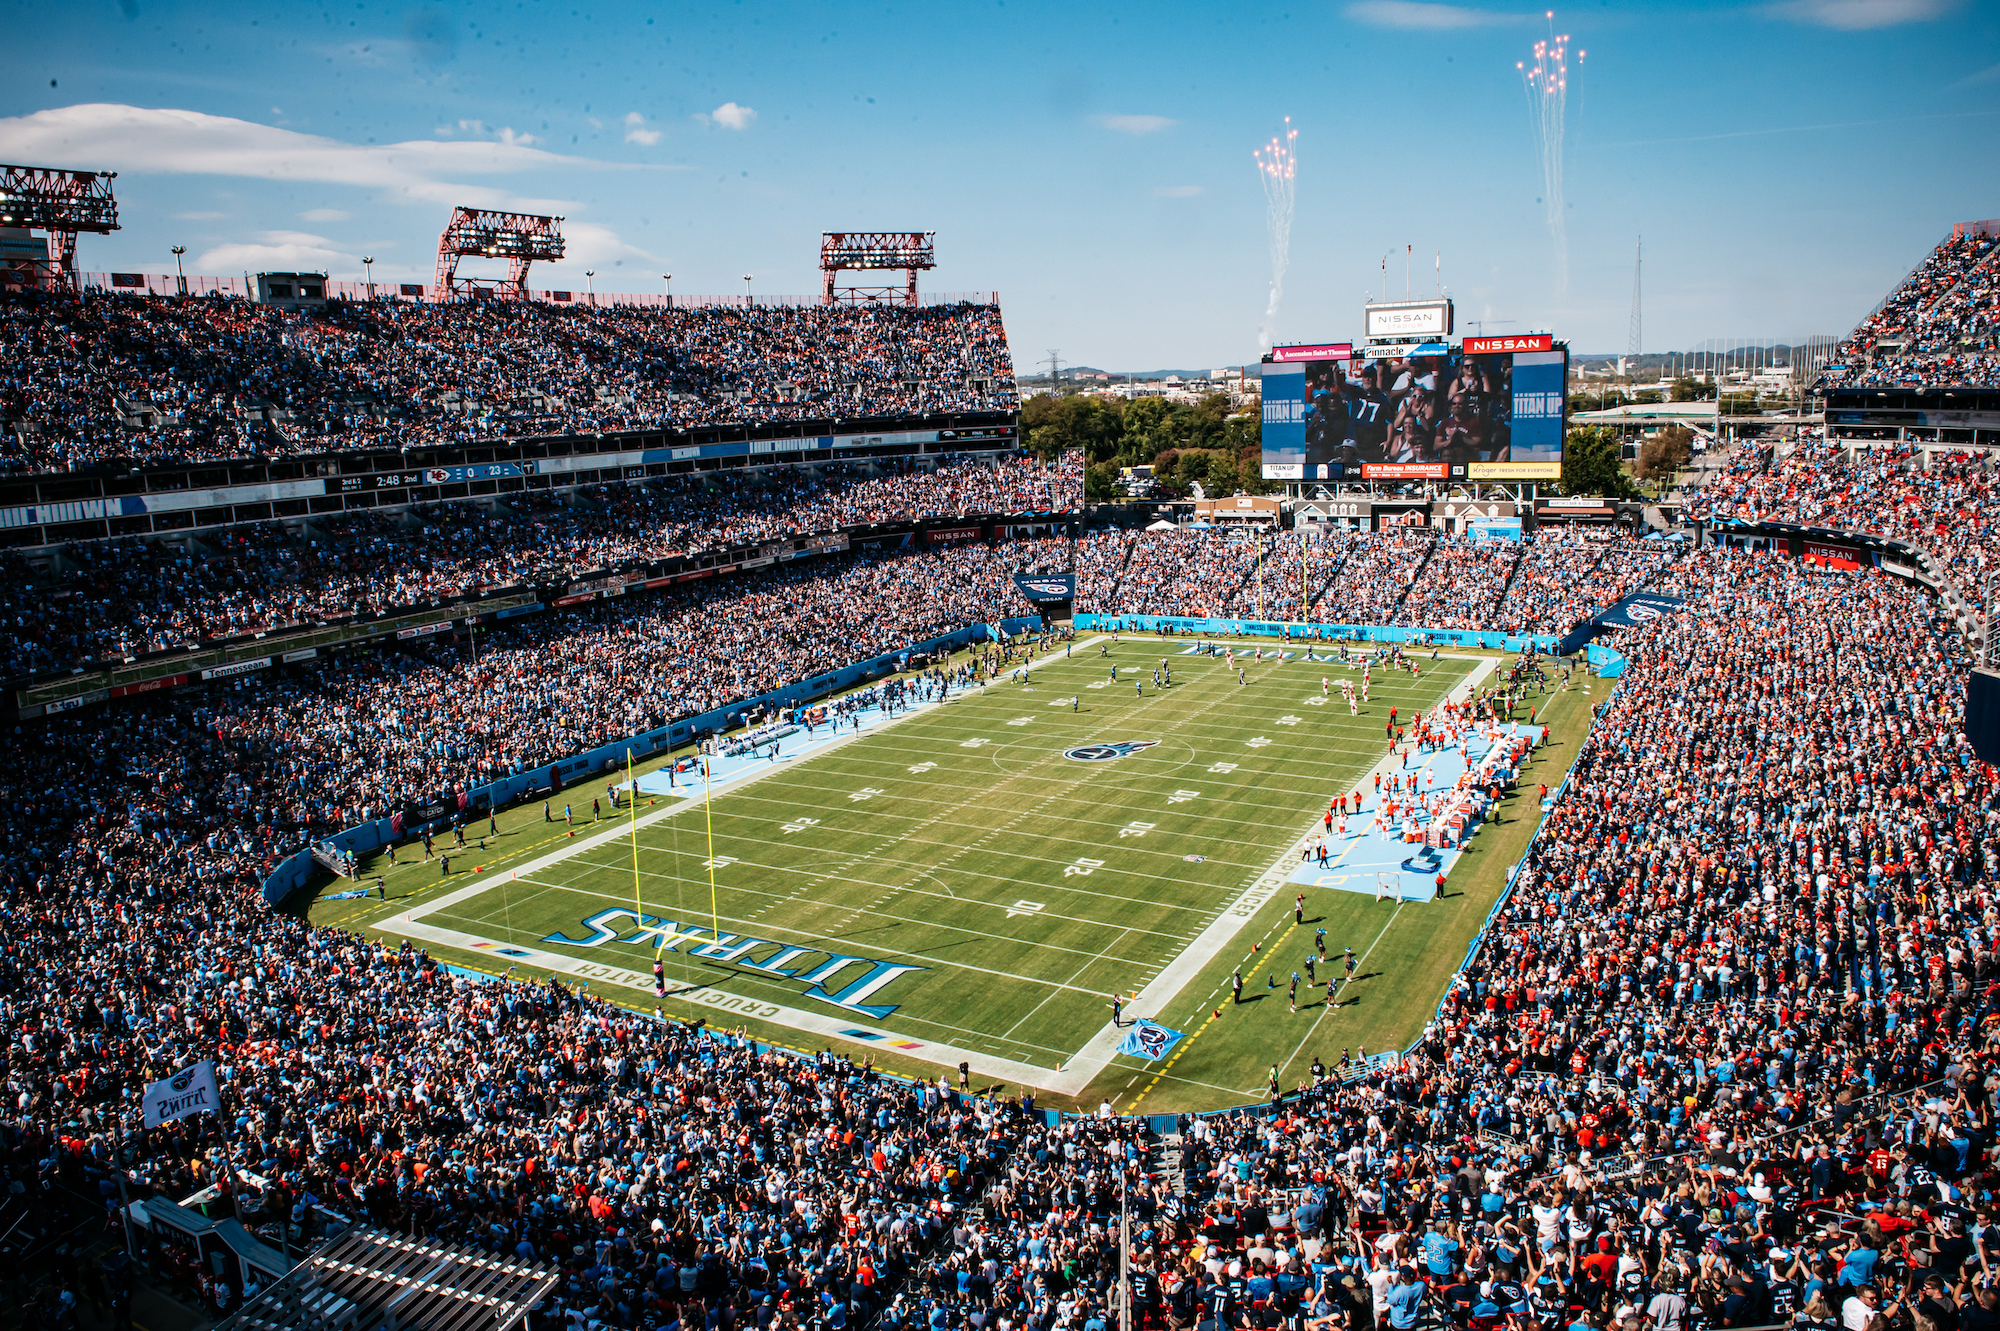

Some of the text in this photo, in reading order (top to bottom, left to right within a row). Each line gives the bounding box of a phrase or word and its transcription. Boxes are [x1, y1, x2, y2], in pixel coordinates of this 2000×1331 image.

[1378, 312, 1432, 322] NISSAN
[1387, 322, 1424, 330] STADIUM
[1473, 338, 1540, 350] NISSAN
[1365, 346, 1404, 358] Pinnacle
[1262, 403, 1306, 420] TITAN UP
[1356, 398, 1381, 423] 77
[1513, 397, 1563, 415] TITAN UP
[466, 468, 474, 478] 0
[488, 466, 501, 476] 23
[1366, 464, 1443, 472] Farm Bureau INSURANCE
[1473, 464, 1496, 477] Kroger
[376, 474, 418, 487] 2:48 2nd
[934, 532, 975, 540] NISSAN
[1809, 546, 1853, 560] NISSAN
[208, 660, 268, 678] Tennessean.
[960, 737, 991, 748] 50
[907, 761, 938, 772] 40
[1206, 761, 1239, 774] 50
[848, 787, 885, 800] 30
[1168, 789, 1201, 802] 40
[780, 817, 821, 832] 20
[1119, 820, 1157, 837] 30
[702, 855, 739, 869] 10
[1063, 857, 1106, 876] 20
[1228, 878, 1280, 918] CANCER
[1006, 899, 1046, 917] 10
[541, 907, 933, 1020] TITANS
[574, 964, 657, 988] CATCH
[1876, 1159, 1887, 1169] 15
[1913, 1170, 1934, 1186] 22
[1427, 1244, 1444, 1263] 22
[1214, 1297, 1226, 1313] 11
